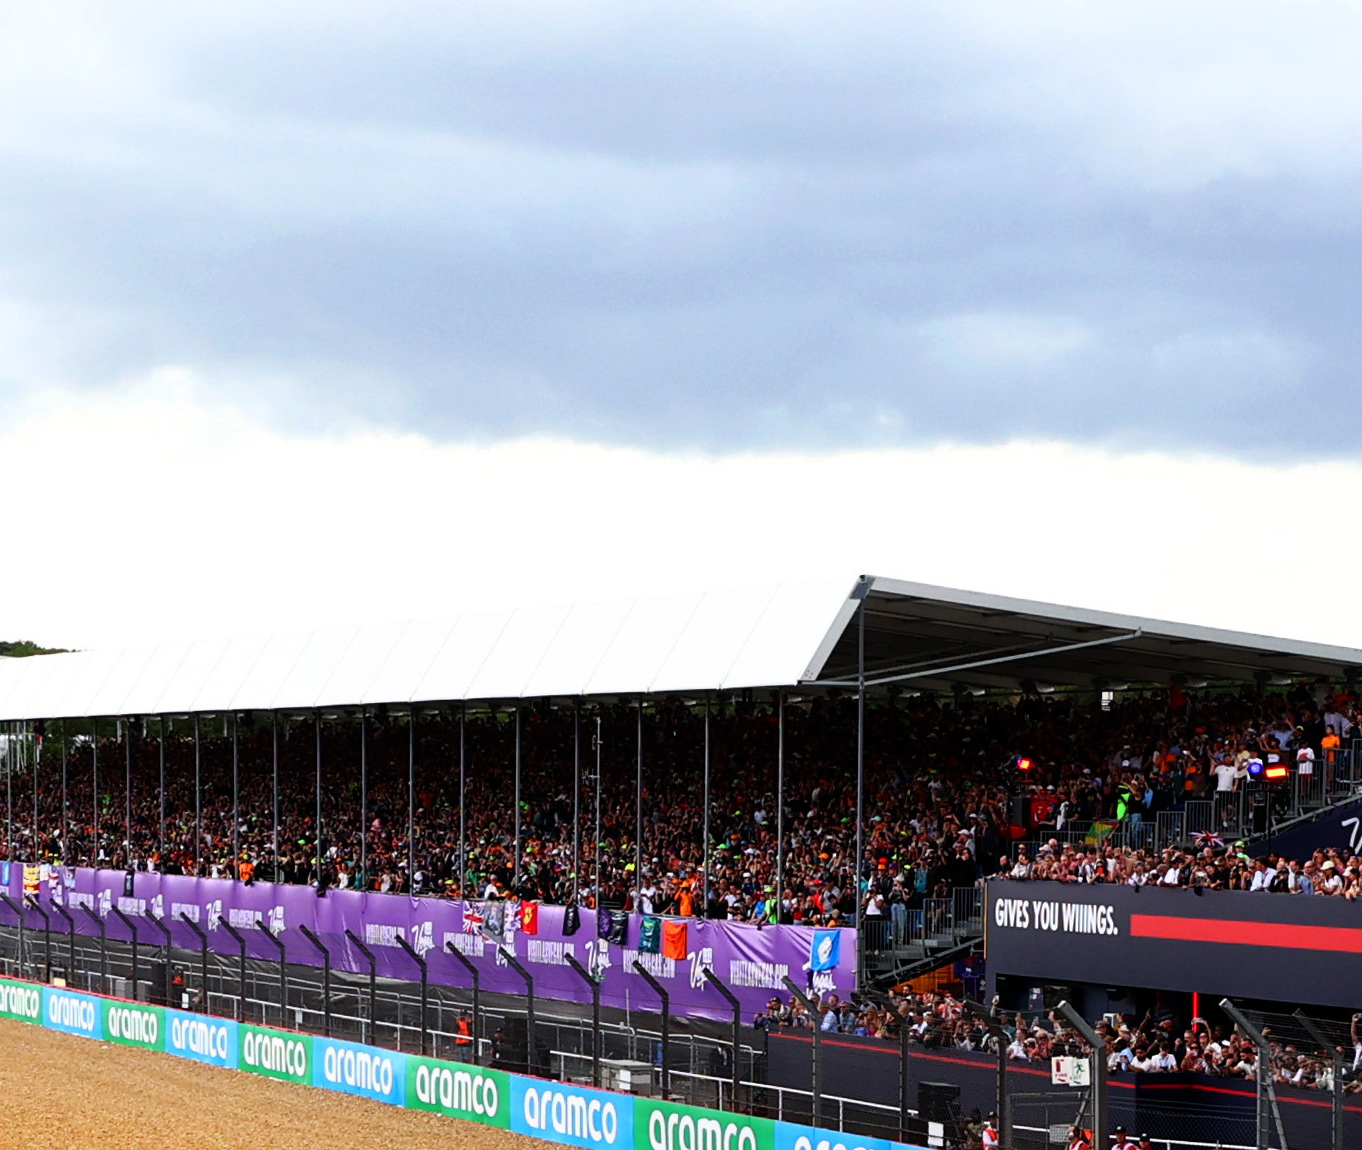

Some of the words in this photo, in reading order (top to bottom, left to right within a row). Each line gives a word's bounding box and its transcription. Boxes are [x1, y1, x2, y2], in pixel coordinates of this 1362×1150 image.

[995, 898, 1029, 929] GIVES
[1032, 901, 1059, 931] YOU
[1062, 903, 1118, 935] WIIINGS.
[49, 994, 95, 1031] aramco
[109, 1007, 157, 1043] aramco
[173, 1017, 228, 1058] aramco
[244, 1031, 306, 1076] aramco
[324, 1046, 393, 1095] aramco
[416, 1065, 498, 1117] aramco
[524, 1088, 617, 1143] aramco
